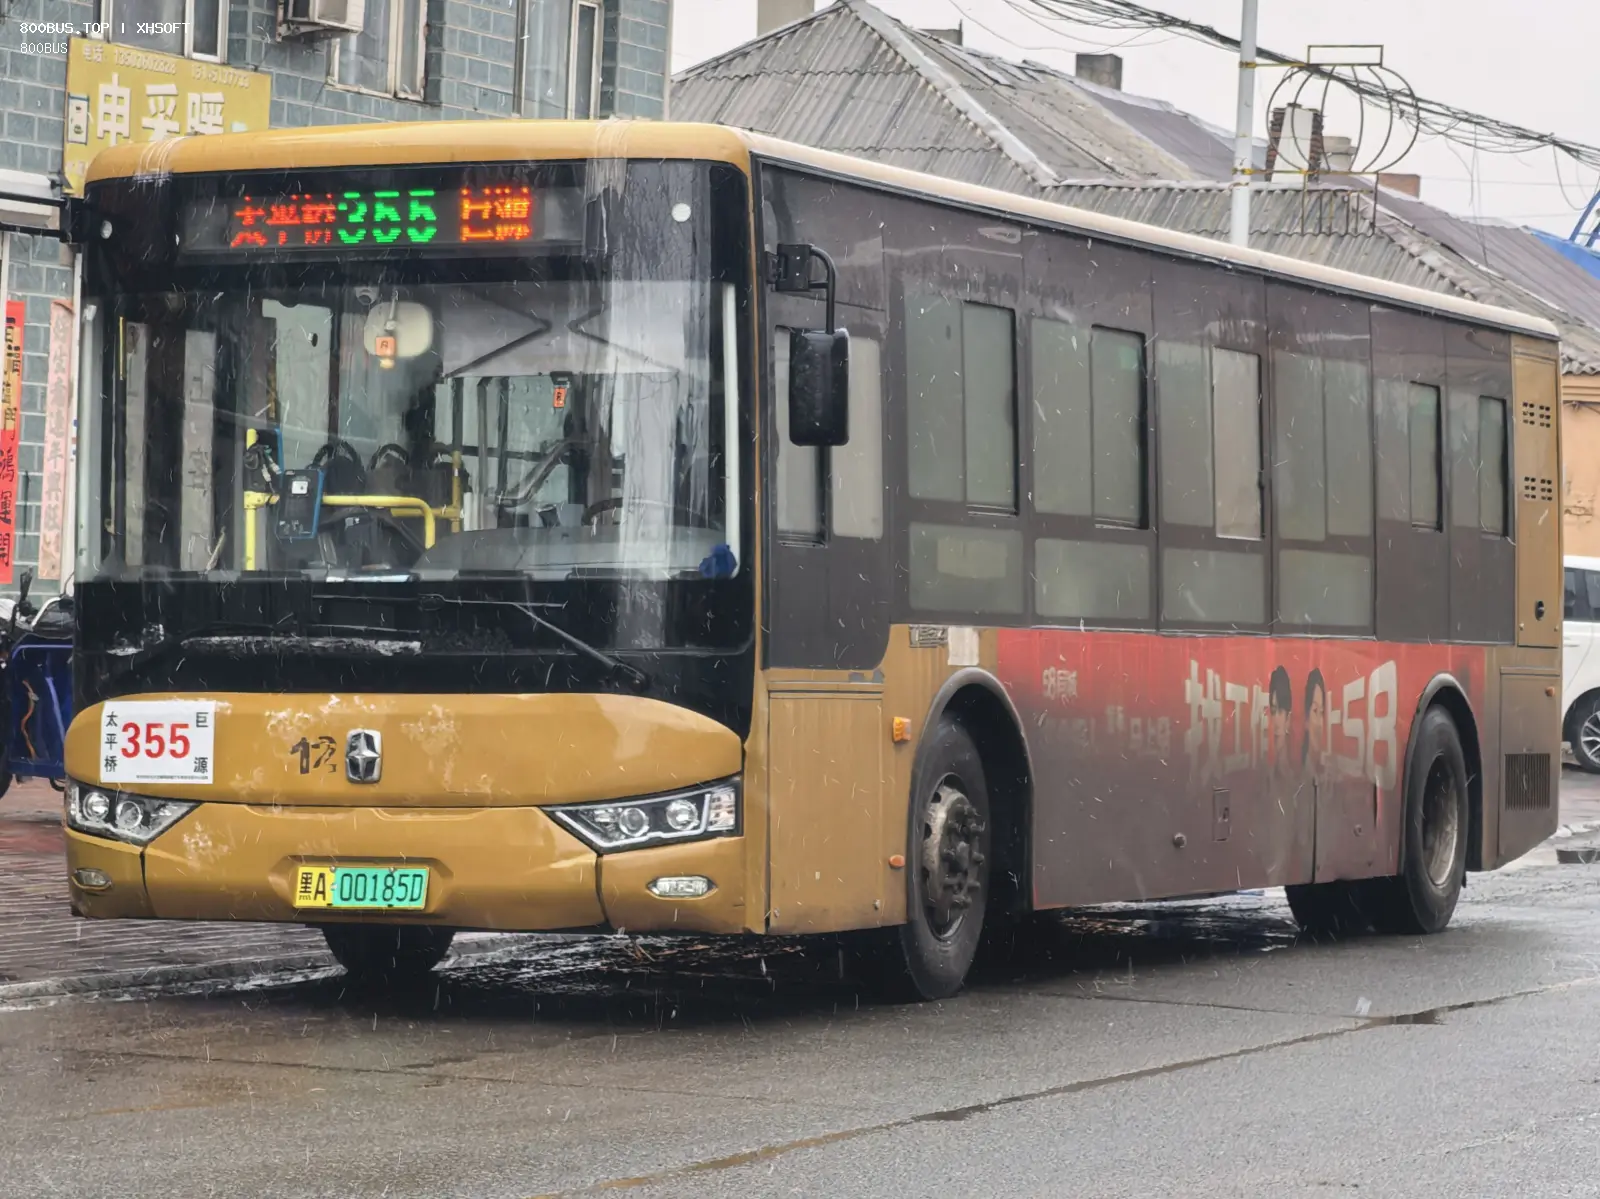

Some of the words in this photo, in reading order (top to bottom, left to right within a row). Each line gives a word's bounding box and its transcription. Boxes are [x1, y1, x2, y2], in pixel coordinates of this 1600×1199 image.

[337, 190, 437, 244] 355
[104, 711, 118, 773] 太平桥
[121, 721, 191, 759] 355
[193, 711, 209, 774] 巨源
